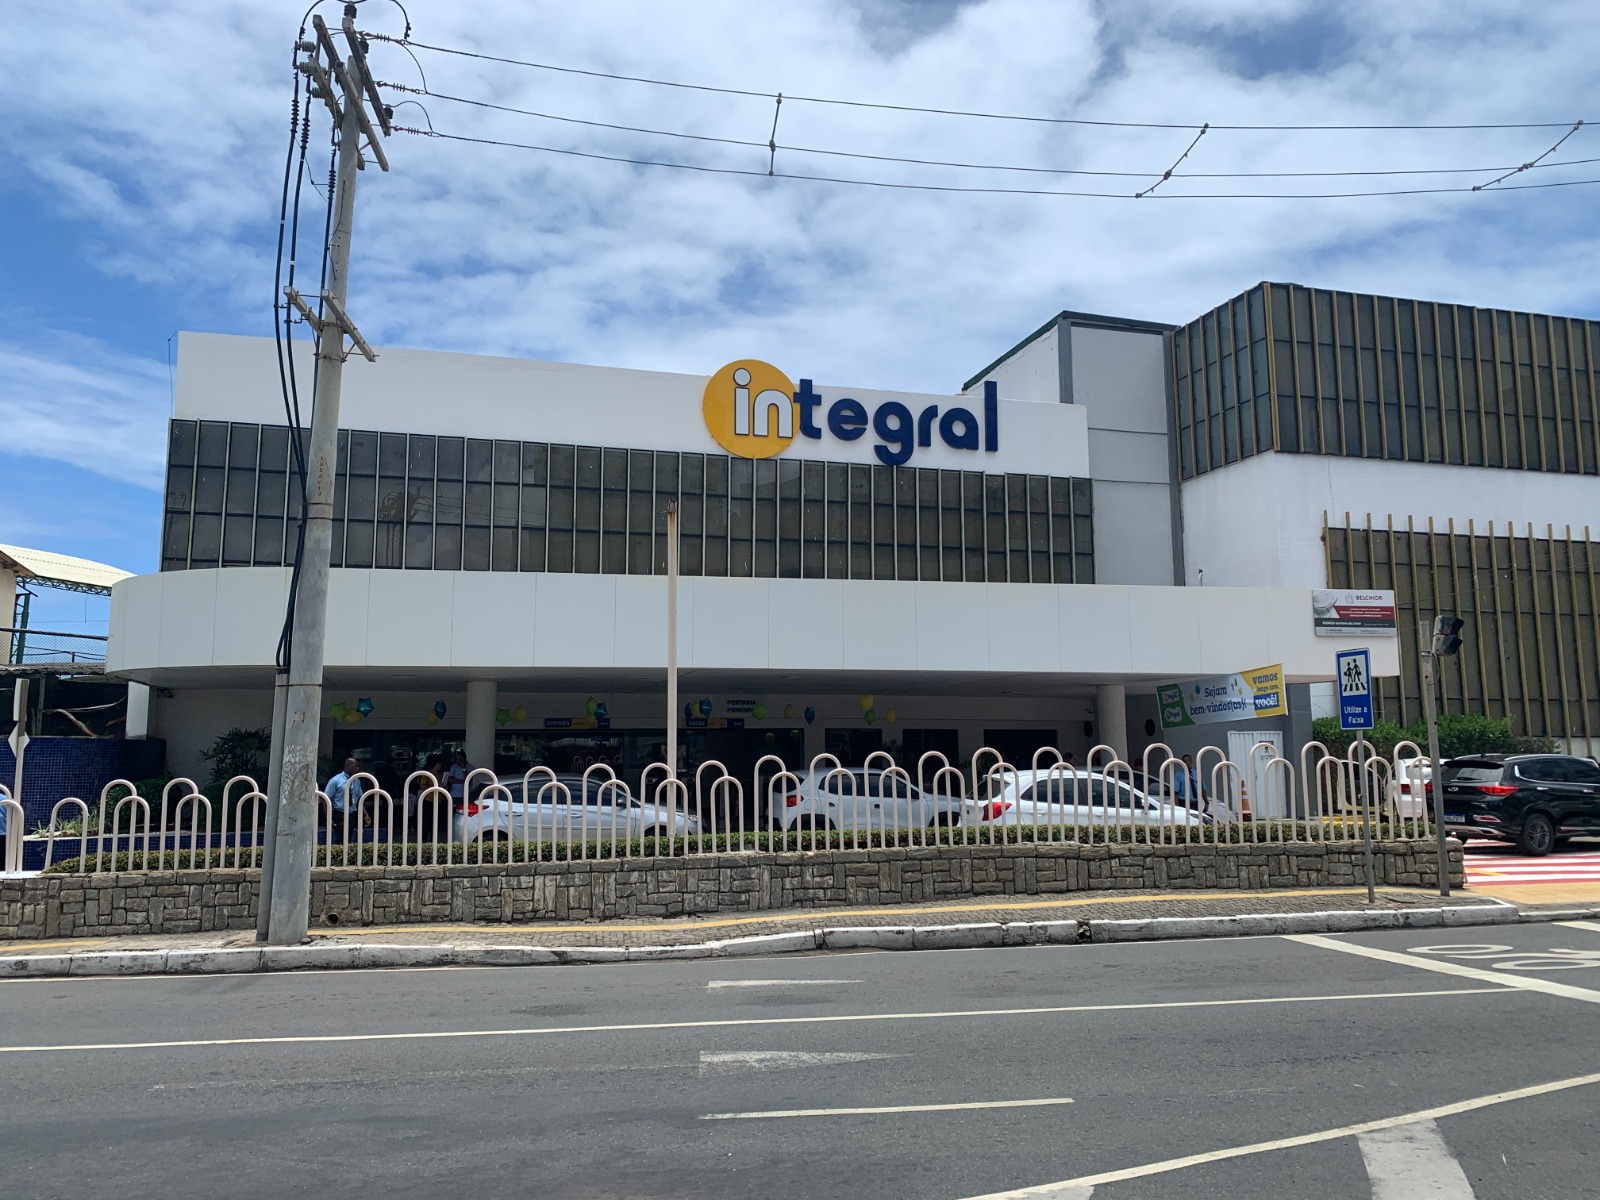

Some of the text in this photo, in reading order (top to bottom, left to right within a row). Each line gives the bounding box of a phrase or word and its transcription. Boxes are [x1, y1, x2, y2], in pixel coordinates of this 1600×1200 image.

[733, 368, 999, 466] integral
[1252, 672, 1279, 685] vamos
[1204, 686, 1228, 698] Sejam
[1255, 693, 1278, 708] você!
[1343, 705, 1362, 714] Utilize
[1348, 716, 1365, 724] Faixa
